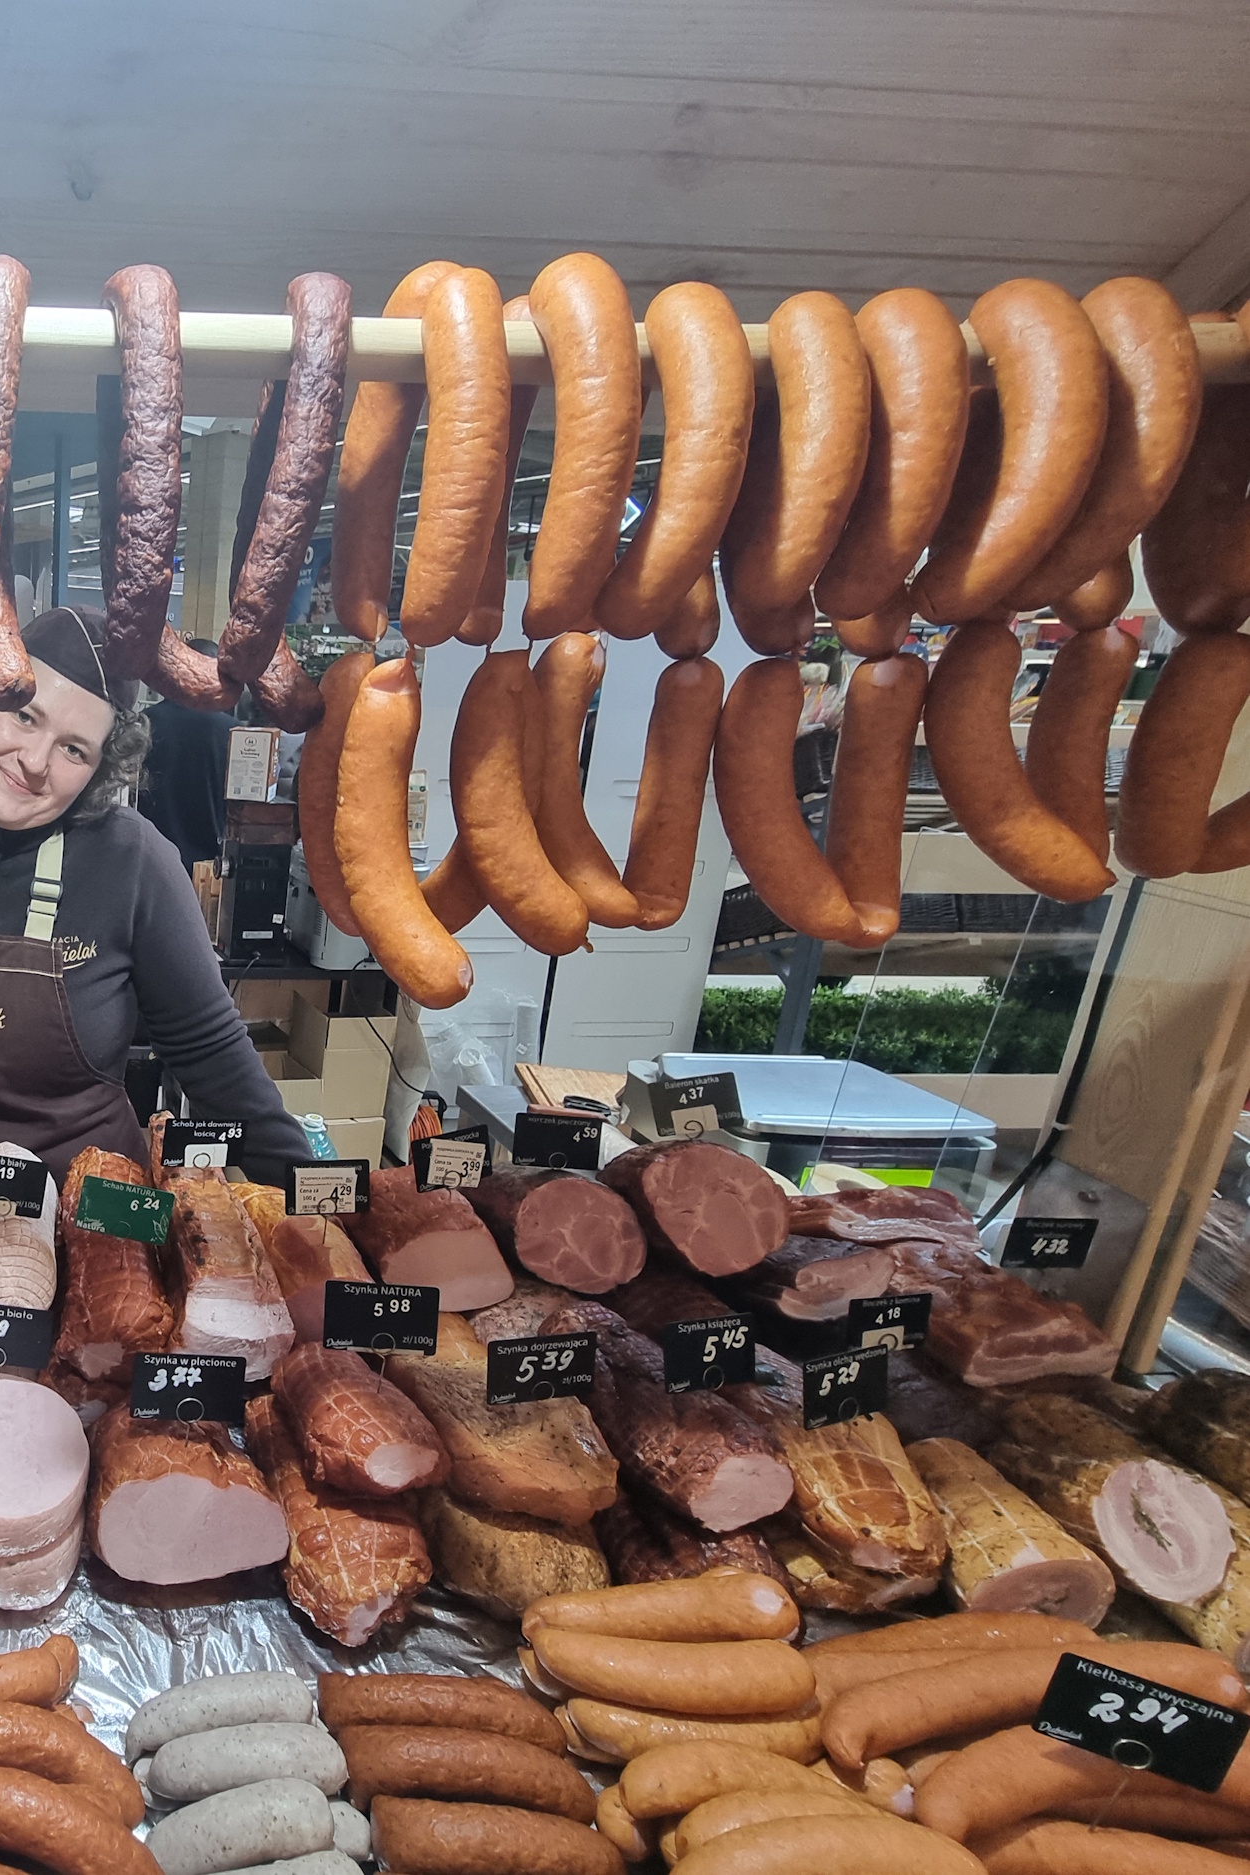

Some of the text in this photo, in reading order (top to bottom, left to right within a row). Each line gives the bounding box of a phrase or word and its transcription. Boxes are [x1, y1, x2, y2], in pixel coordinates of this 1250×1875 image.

[52, 935, 80, 944] RACIA
[172, 1120, 195, 1128] Schab
[102, 1180, 156, 1198] Schab NATURA
[76, 1219, 106, 1233] Natura
[344, 1284, 422, 1297] Szynka NATURA
[6, 1308, 33, 1320] biała
[678, 1322, 706, 1334] Szynka
[497, 1339, 589, 1356] Szynka dojrzewająca
[144, 1354, 178, 1367] Szynka
[190, 1357, 237, 1368] plecionce
[1076, 1660, 1236, 1725] Kiełbasa zwyczajna
